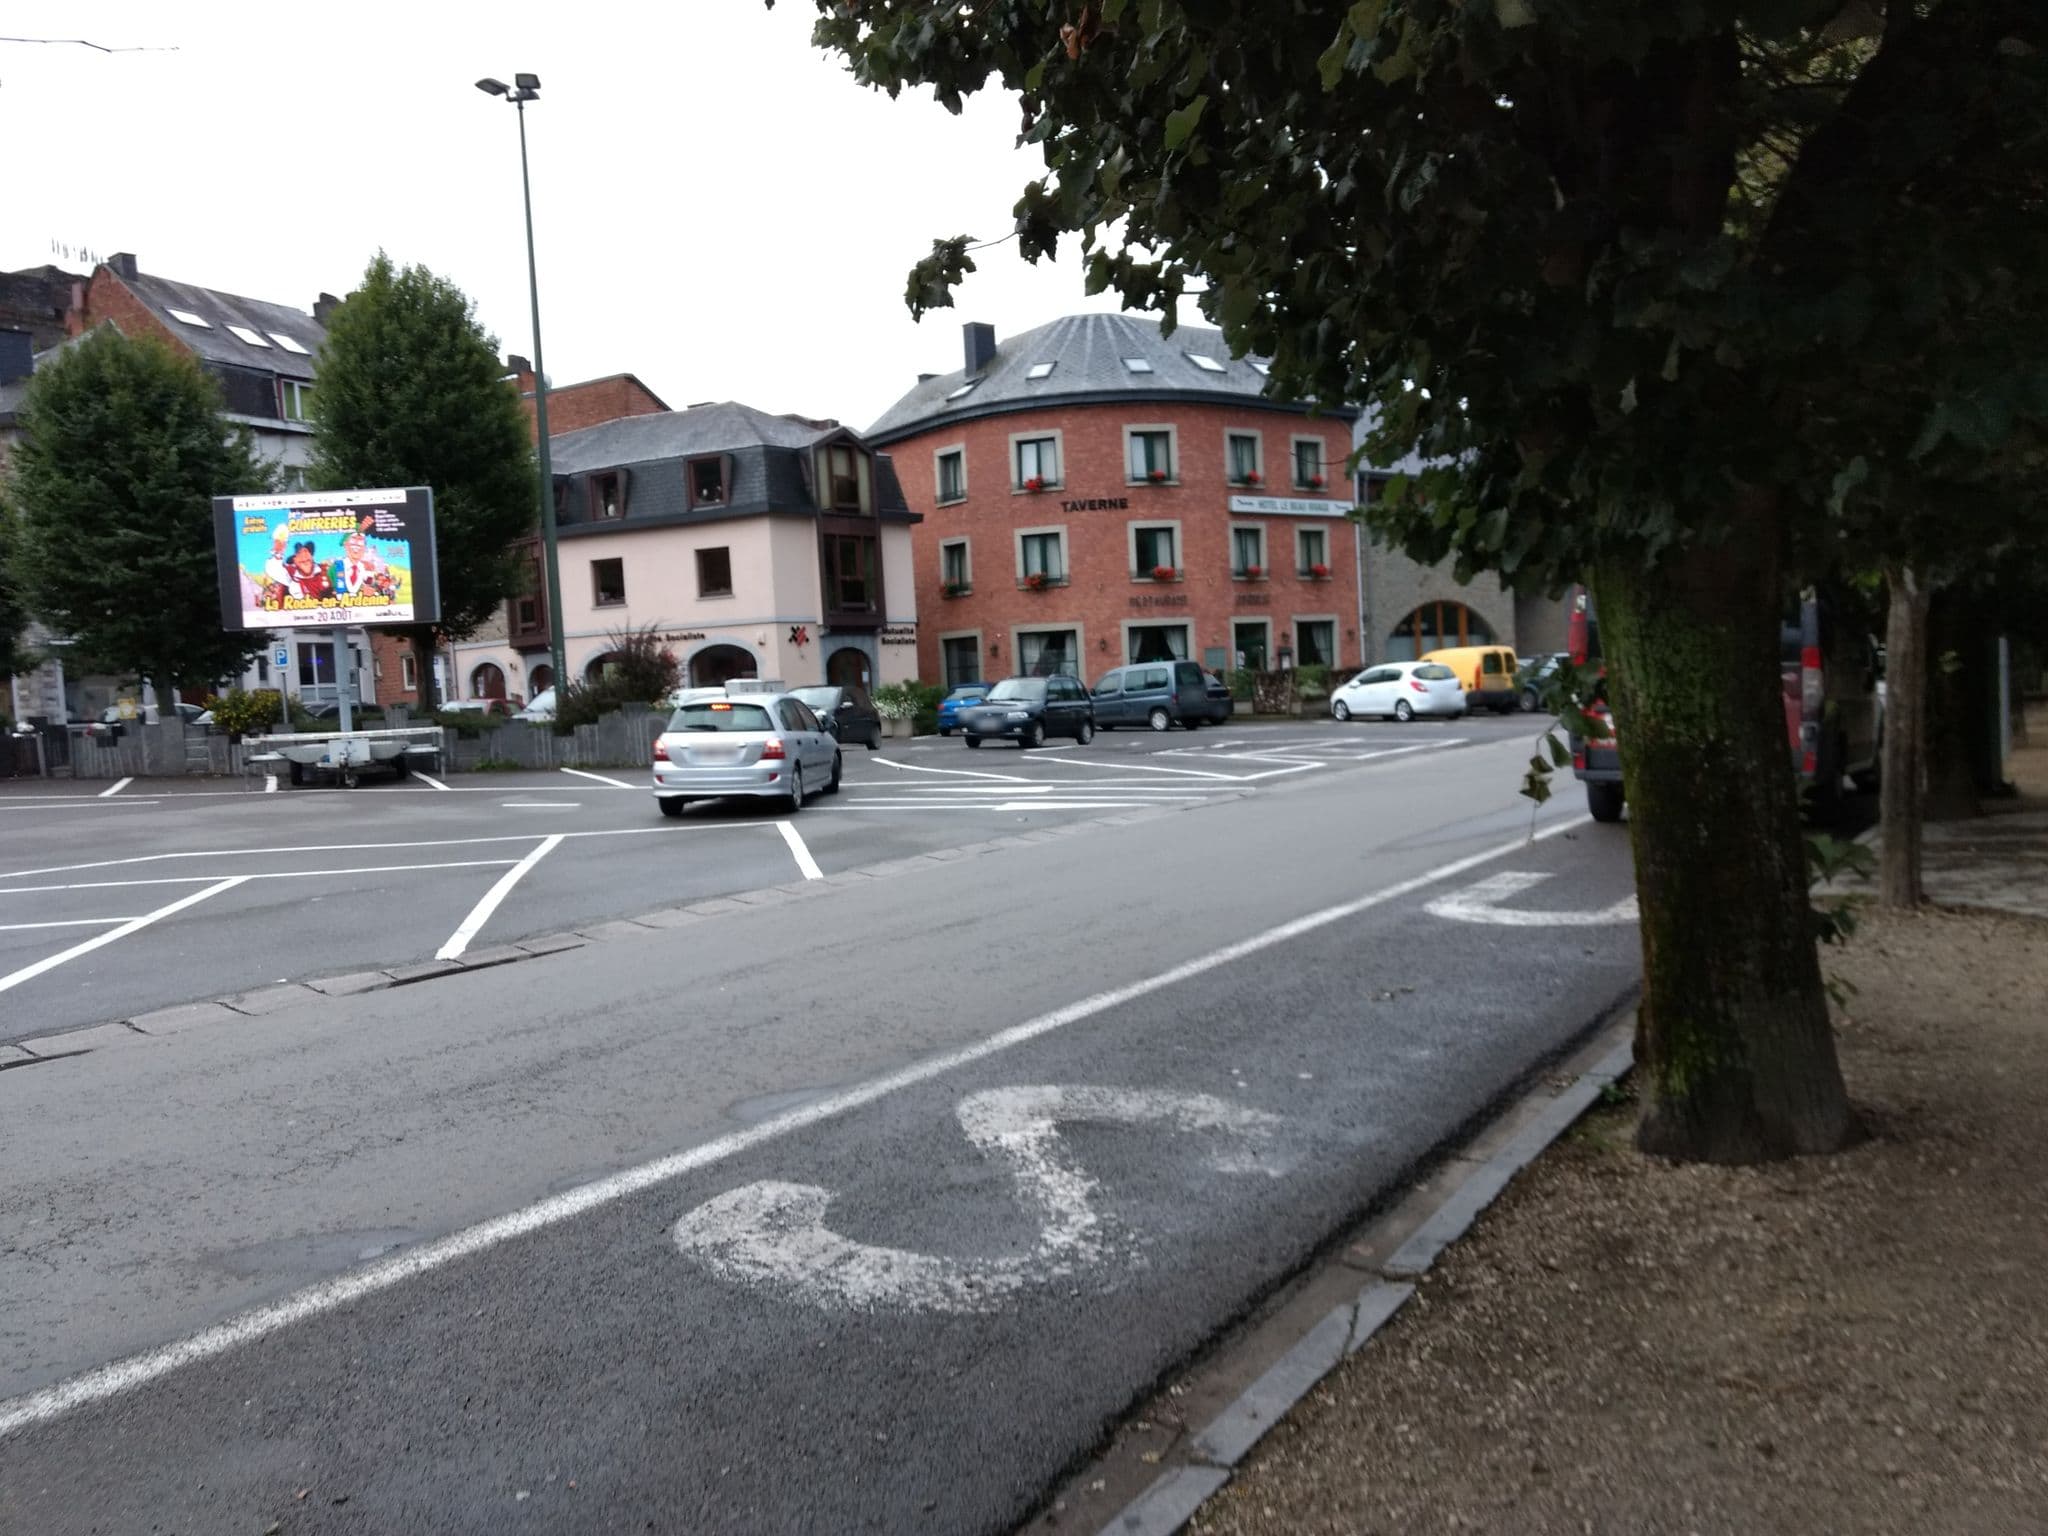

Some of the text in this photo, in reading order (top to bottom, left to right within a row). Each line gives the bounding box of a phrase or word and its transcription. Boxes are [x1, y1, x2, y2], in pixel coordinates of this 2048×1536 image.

[1060, 498, 1128, 513] TAVERNE
[264, 591, 390, 611] La Roche-en-Ardenne
[317, 611, 328, 622] 20
